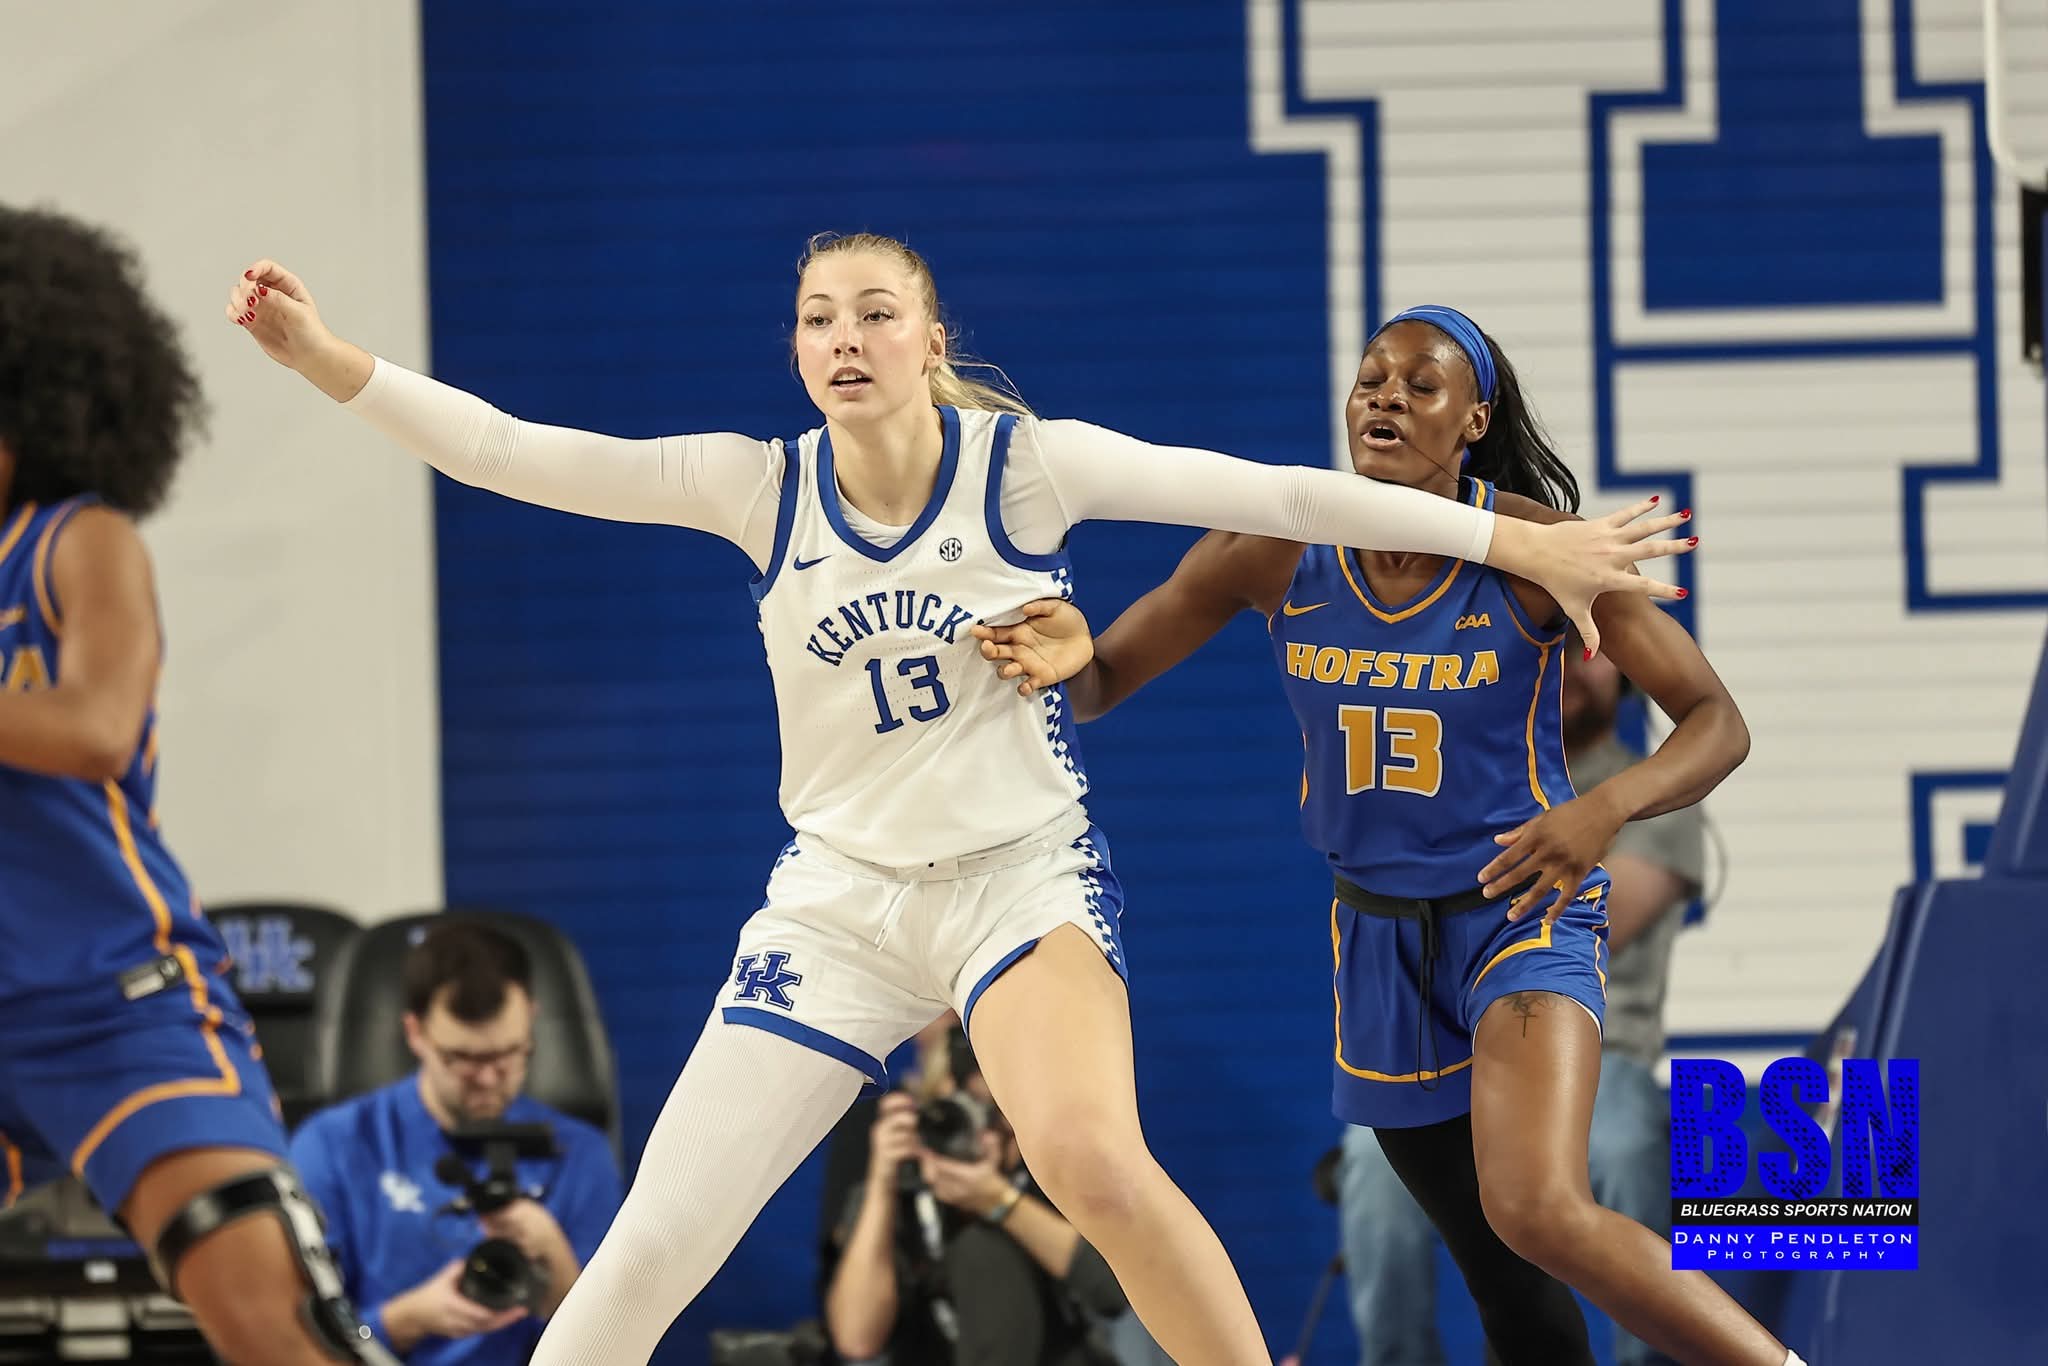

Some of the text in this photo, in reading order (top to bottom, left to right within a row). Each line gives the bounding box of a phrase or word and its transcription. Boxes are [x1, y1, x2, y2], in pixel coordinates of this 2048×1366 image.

[939, 537, 963, 562] SEC
[807, 590, 984, 667] KENTUCK
[1455, 613, 1491, 631] CAA
[865, 655, 950, 734] 13
[1286, 641, 1500, 690] HOFSTRA
[1338, 704, 1443, 798] 13
[734, 951, 803, 1011] UK
